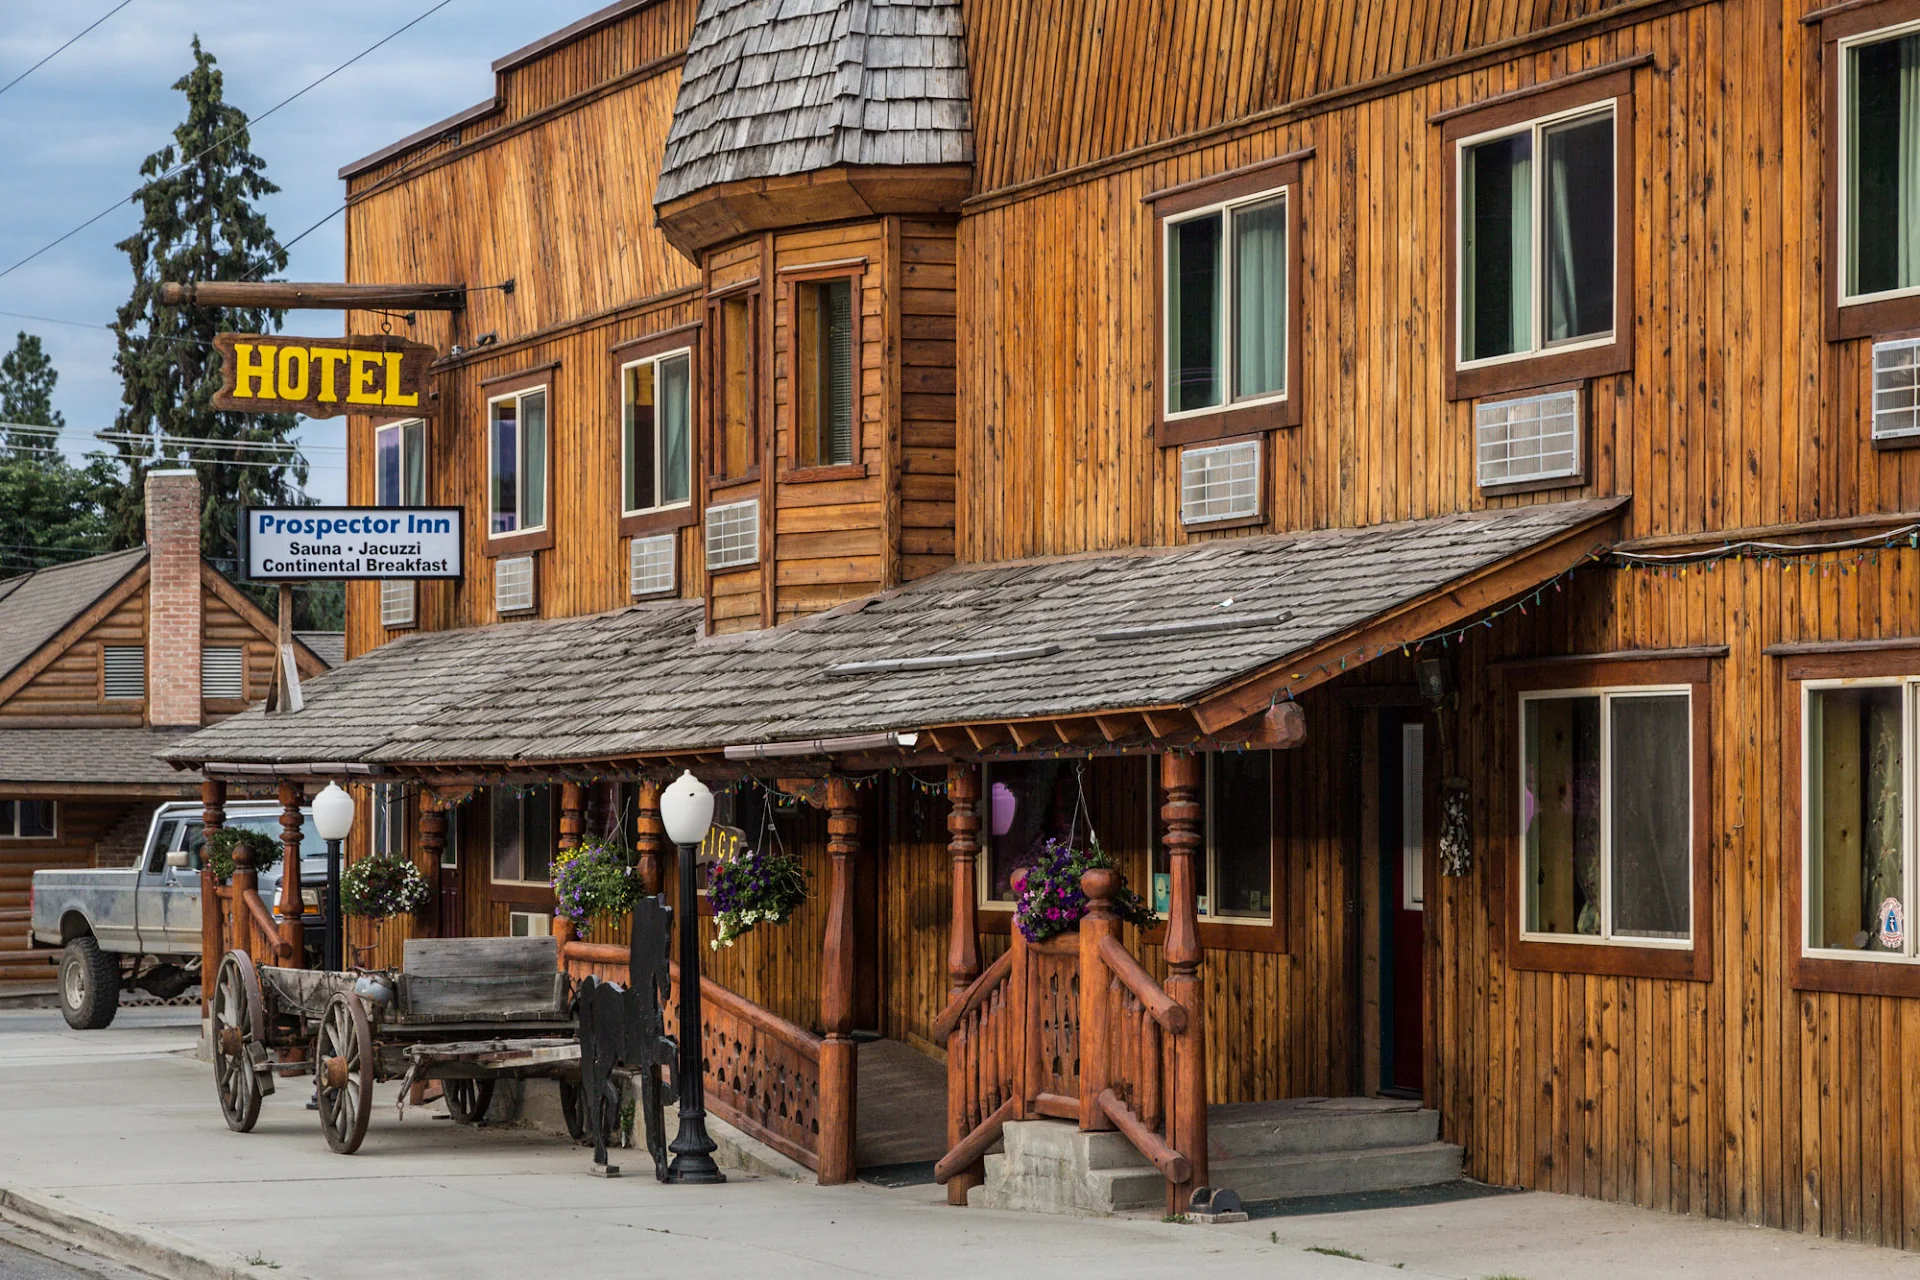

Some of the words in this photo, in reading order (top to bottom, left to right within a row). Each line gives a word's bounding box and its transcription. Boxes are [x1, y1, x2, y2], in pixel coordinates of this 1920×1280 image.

[232, 343, 419, 407] HOTEL
[259, 514, 401, 539] Prospector
[407, 514, 450, 534] Inn
[289, 542, 342, 555] Sauna
[358, 541, 421, 556] Jacuzzi
[262, 558, 360, 572] Continental
[366, 558, 448, 572] Breakfast
